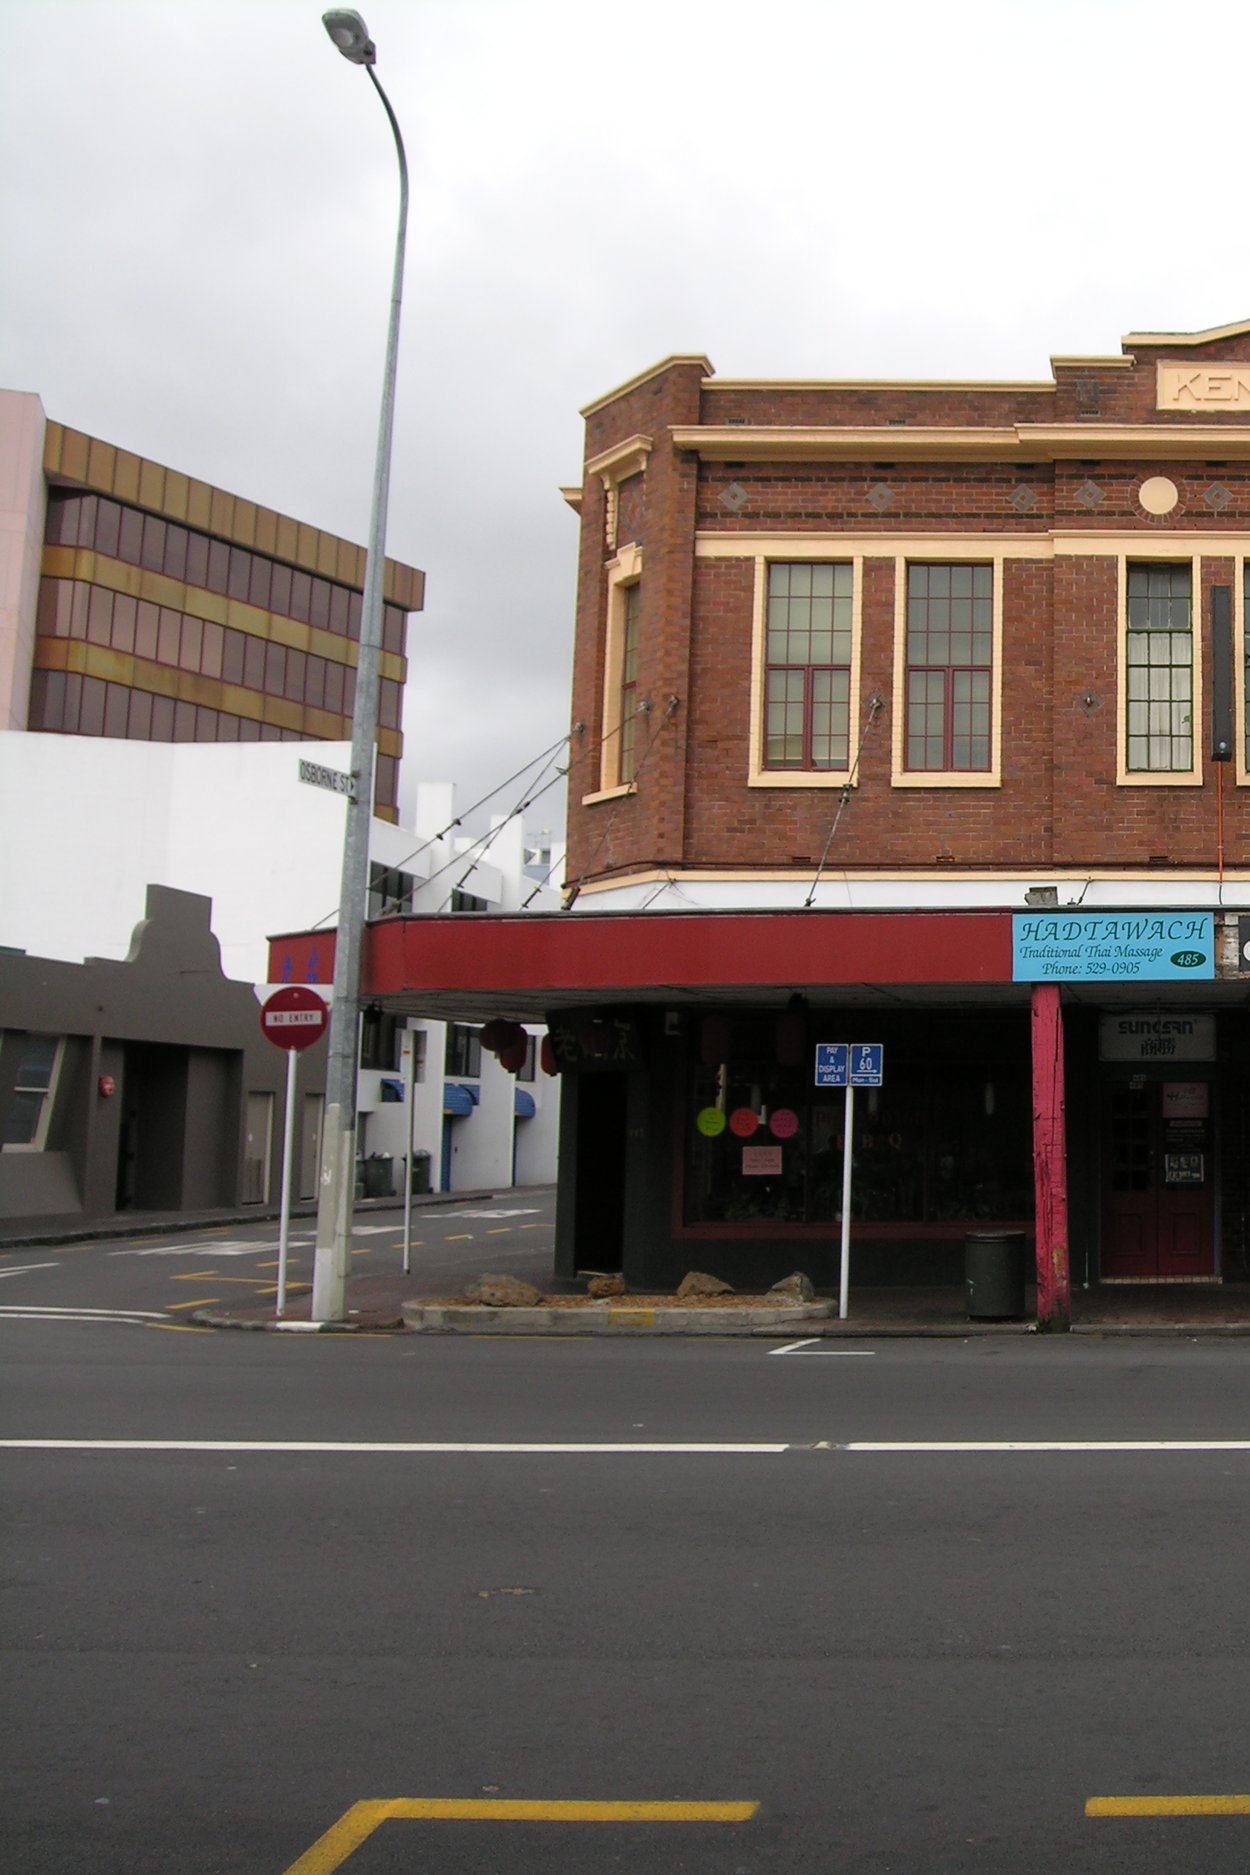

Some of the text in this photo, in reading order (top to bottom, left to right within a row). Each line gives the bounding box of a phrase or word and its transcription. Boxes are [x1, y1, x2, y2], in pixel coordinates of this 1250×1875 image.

[300, 762, 350, 793] OSBORNE ST
[1020, 917, 1208, 942] HADTAWACH
[1019, 943, 1164, 962] Traditional Thai Massage
[1177, 954, 1199, 966] 485
[1042, 961, 1141, 975] Phone: 529-0905
[273, 1013, 314, 1024] NO ENTRY
[826, 1046, 839, 1054] PAY
[862, 1046, 871, 1057] P
[819, 1065, 846, 1073] DISPLAY
[860, 1057, 873, 1070] 60
[823, 1074, 841, 1082] AREA
